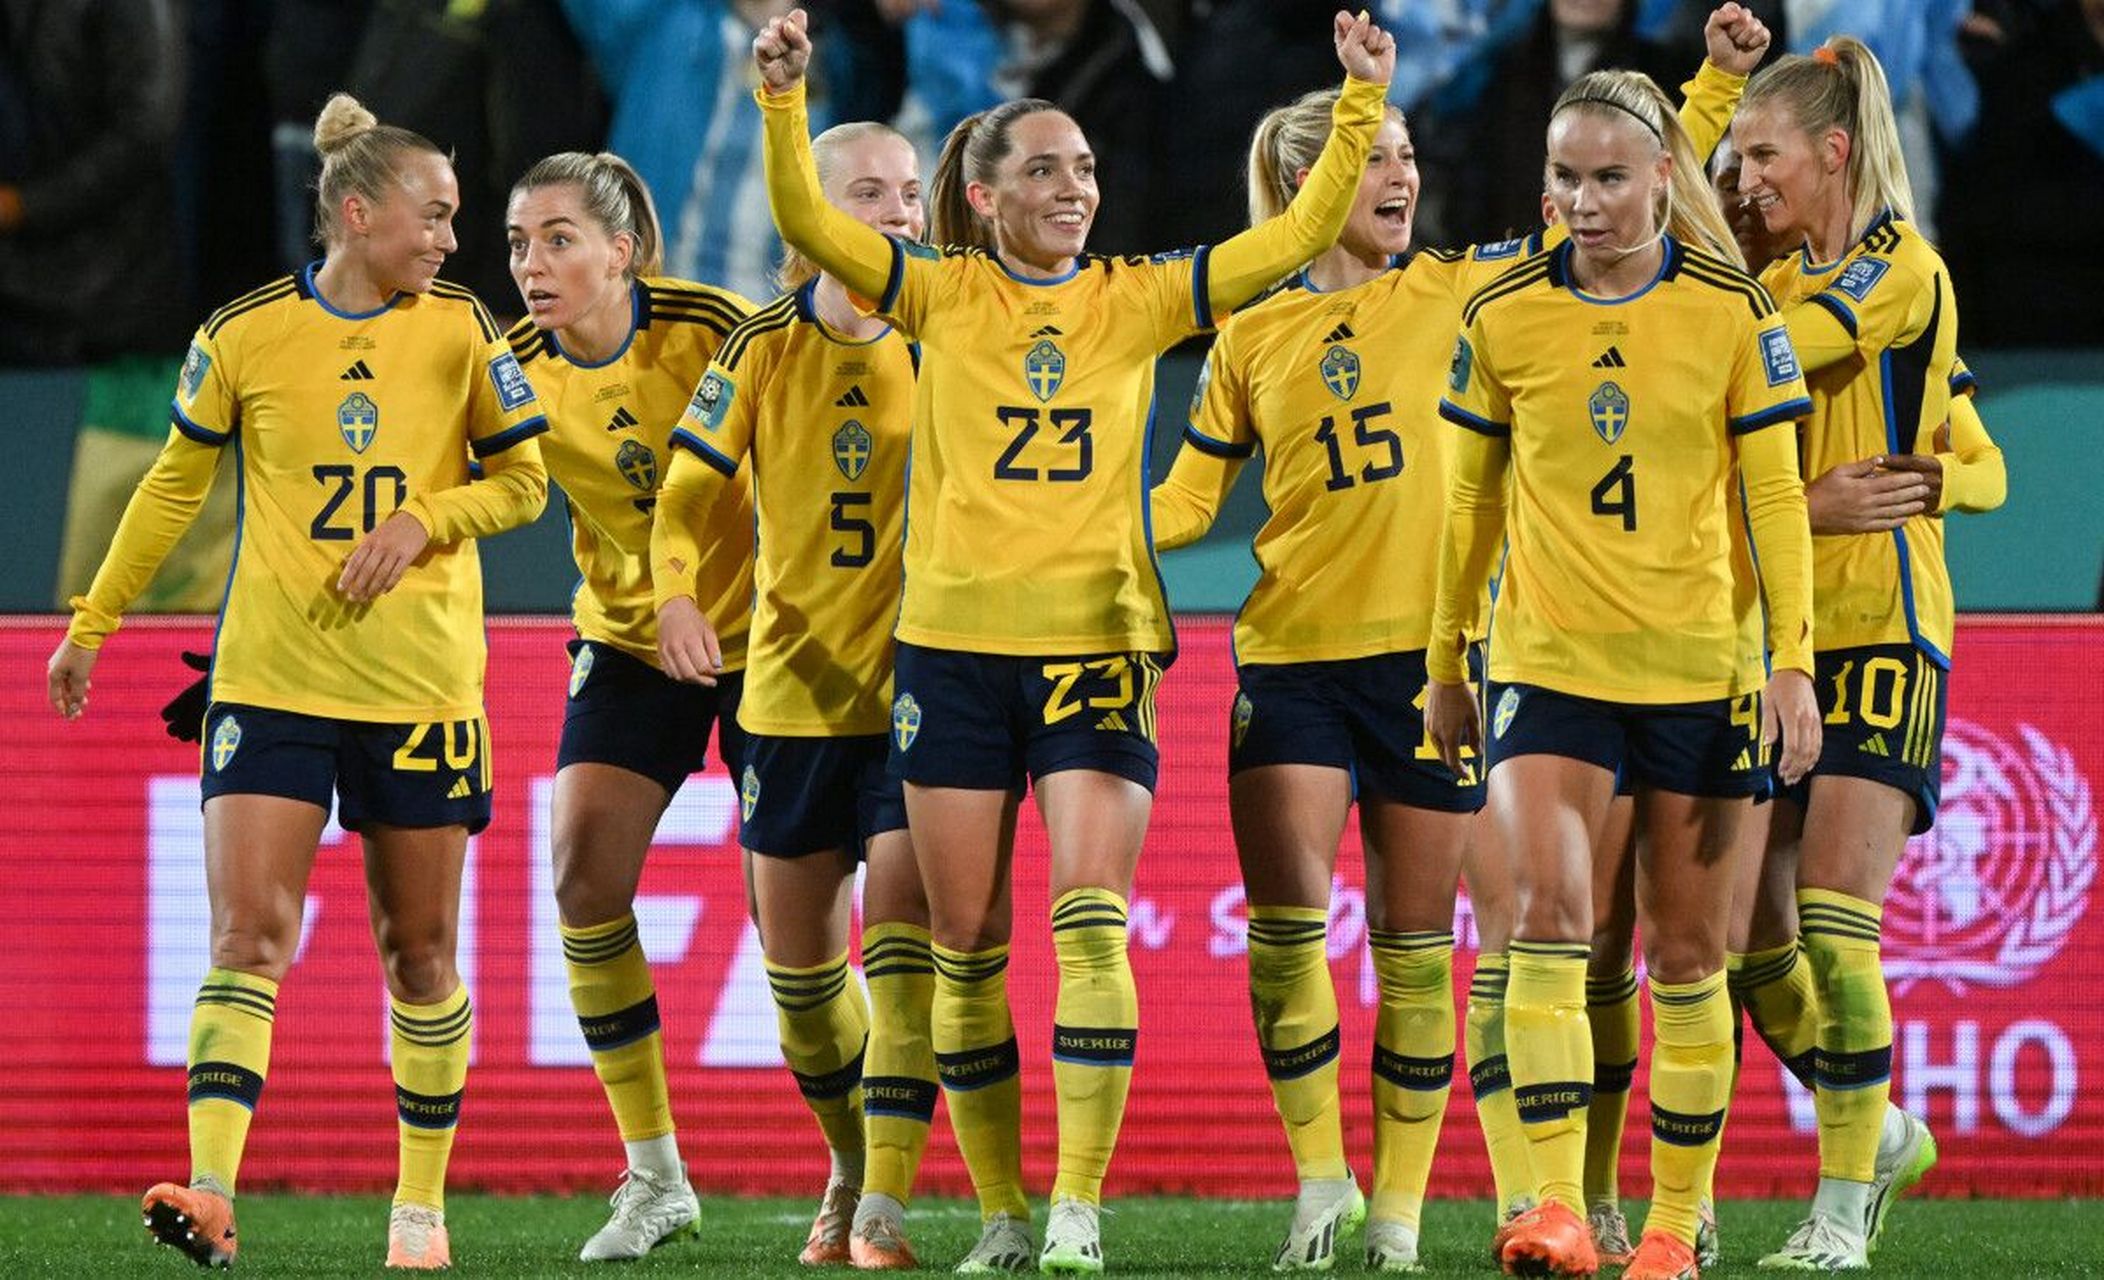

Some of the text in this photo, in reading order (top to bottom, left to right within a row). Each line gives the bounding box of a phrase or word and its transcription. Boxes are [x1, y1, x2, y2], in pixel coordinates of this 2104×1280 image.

[995, 406, 1093, 482] 23
[1314, 402, 1405, 492] 15
[310, 465, 408, 541] 20
[831, 492, 876, 568] 5
[1590, 455, 1637, 532] 4
[1042, 656, 1134, 726] 23
[1824, 656, 1909, 729] 10
[392, 721, 478, 771] 20
[1778, 1019, 2079, 1139] HO
